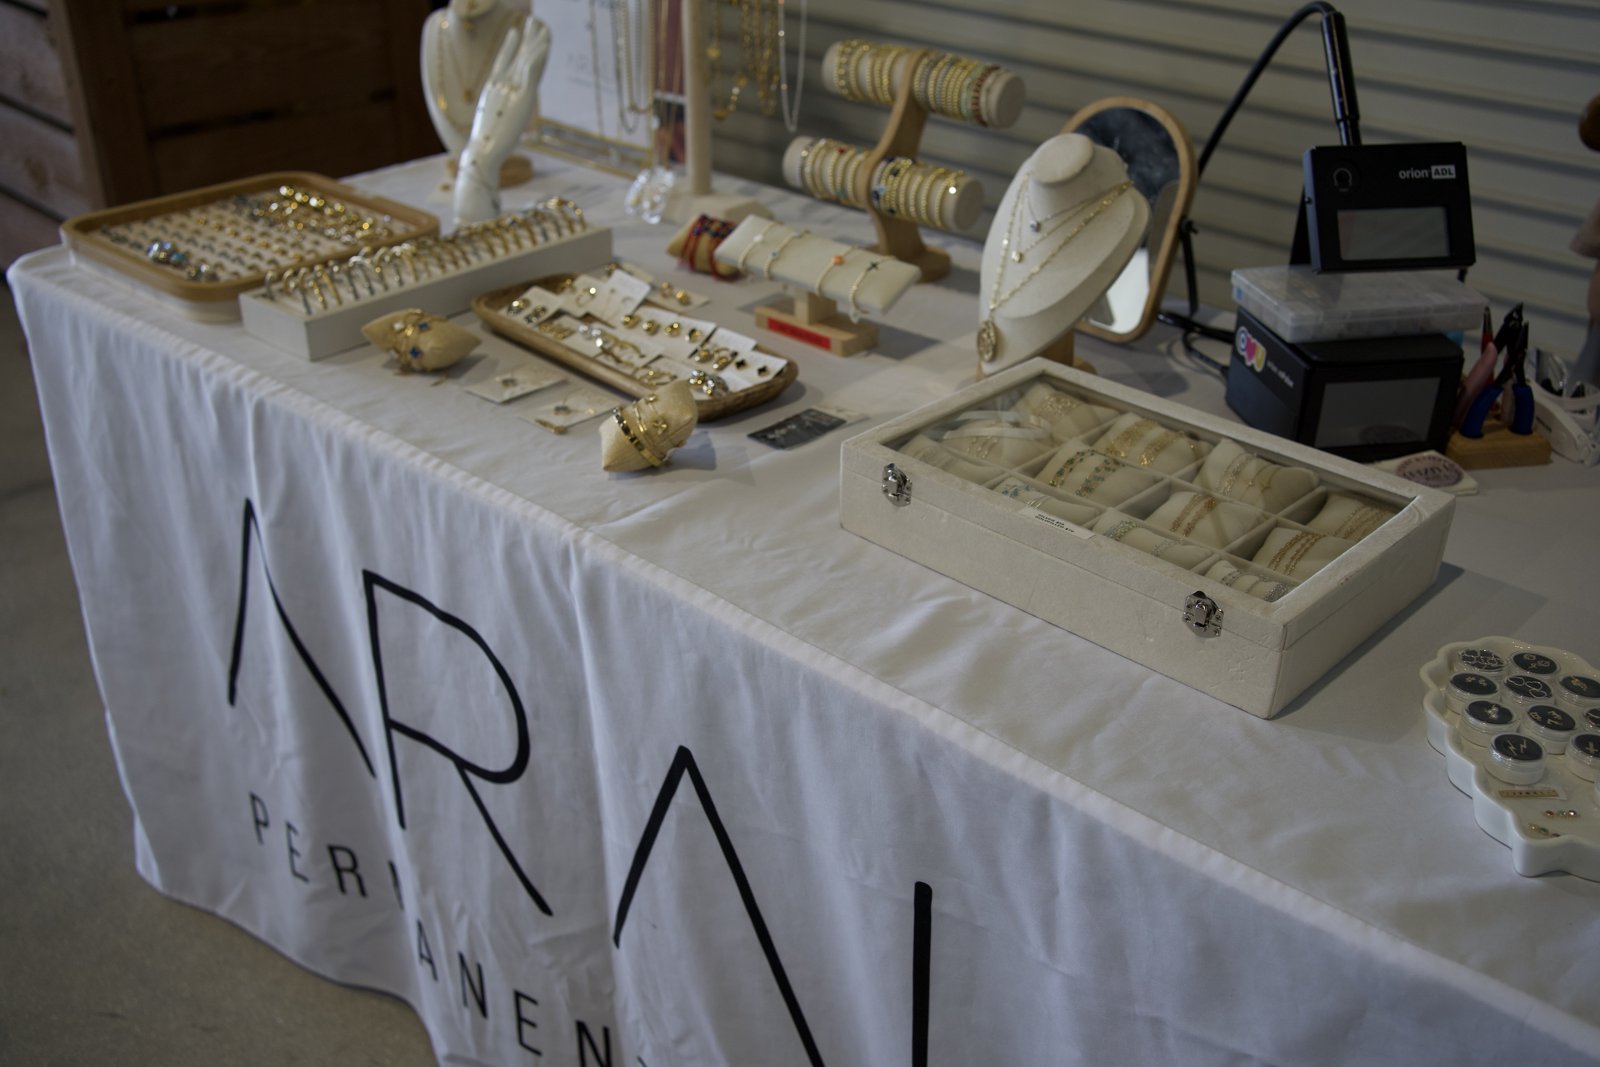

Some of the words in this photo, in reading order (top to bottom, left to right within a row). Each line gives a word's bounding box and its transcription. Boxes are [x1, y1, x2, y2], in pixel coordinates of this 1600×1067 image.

[1398, 167, 1430, 179] orion
[1432, 165, 1456, 179] ADL
[249, 792, 649, 1067] PERANEN
